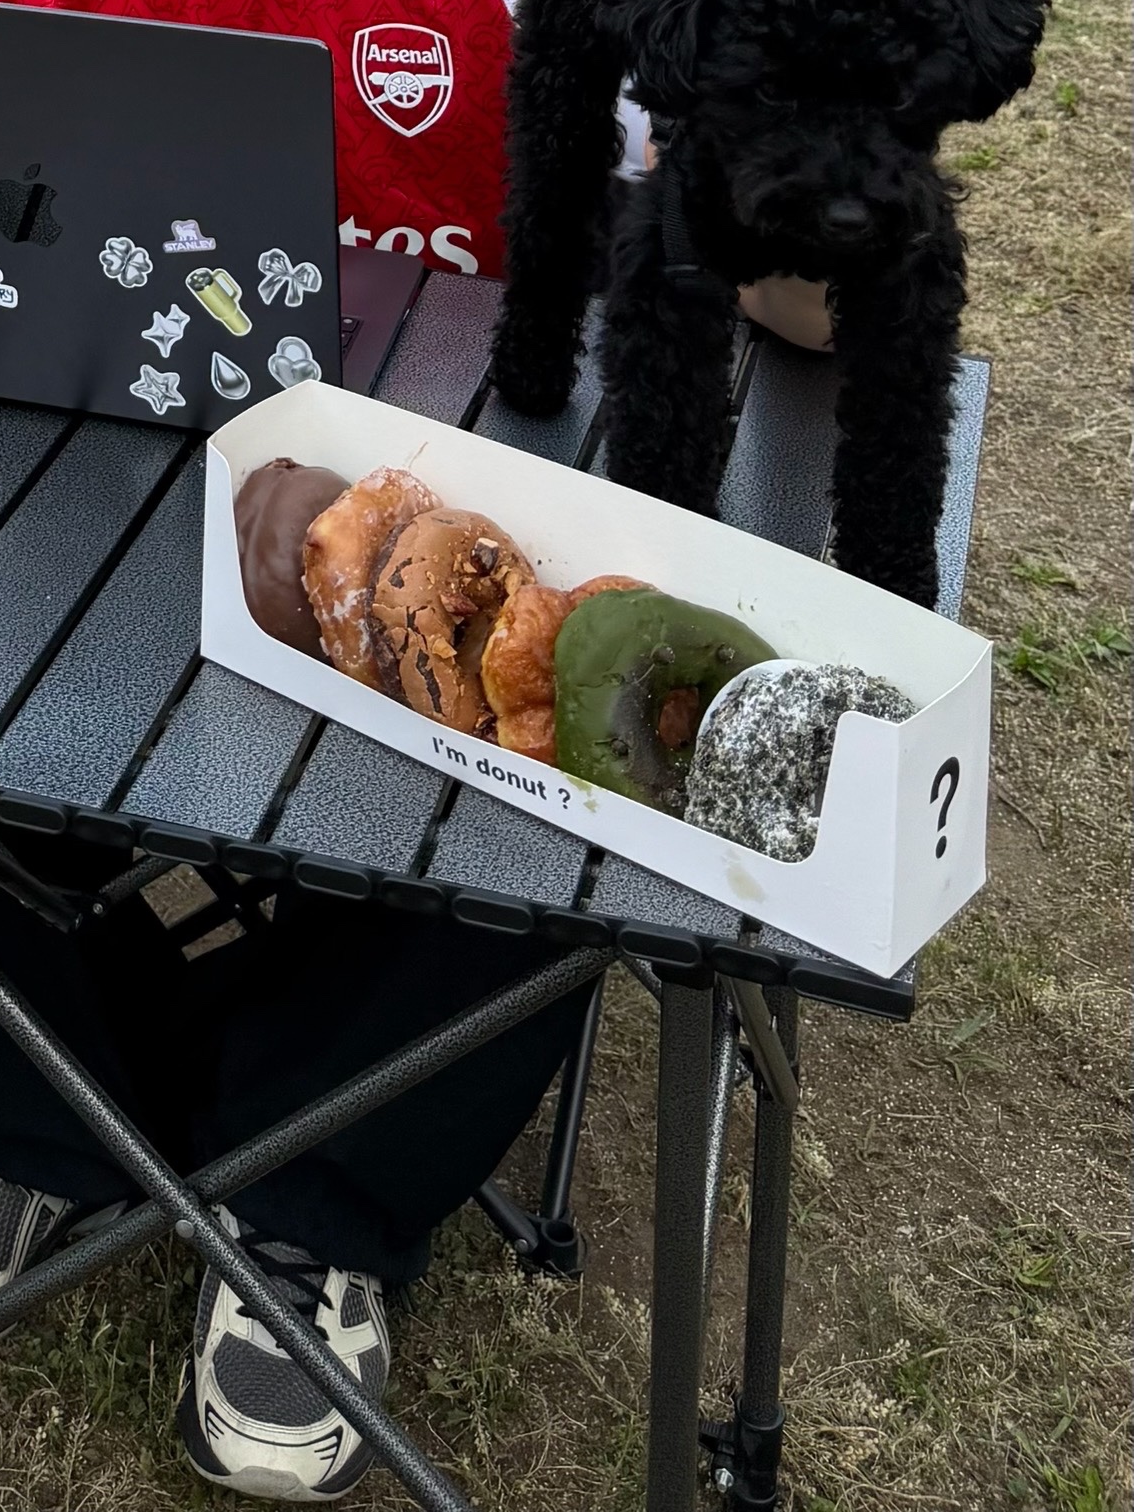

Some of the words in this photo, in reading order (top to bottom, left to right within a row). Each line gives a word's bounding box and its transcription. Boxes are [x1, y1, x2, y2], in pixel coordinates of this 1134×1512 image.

[367, 44, 439, 65] Arsenal
[164, 240, 213, 252] STANLEY
[432, 737, 468, 767] I'm
[476, 758, 547, 800] donut
[558, 788, 571, 810] ?
[930, 756, 960, 859] ?
